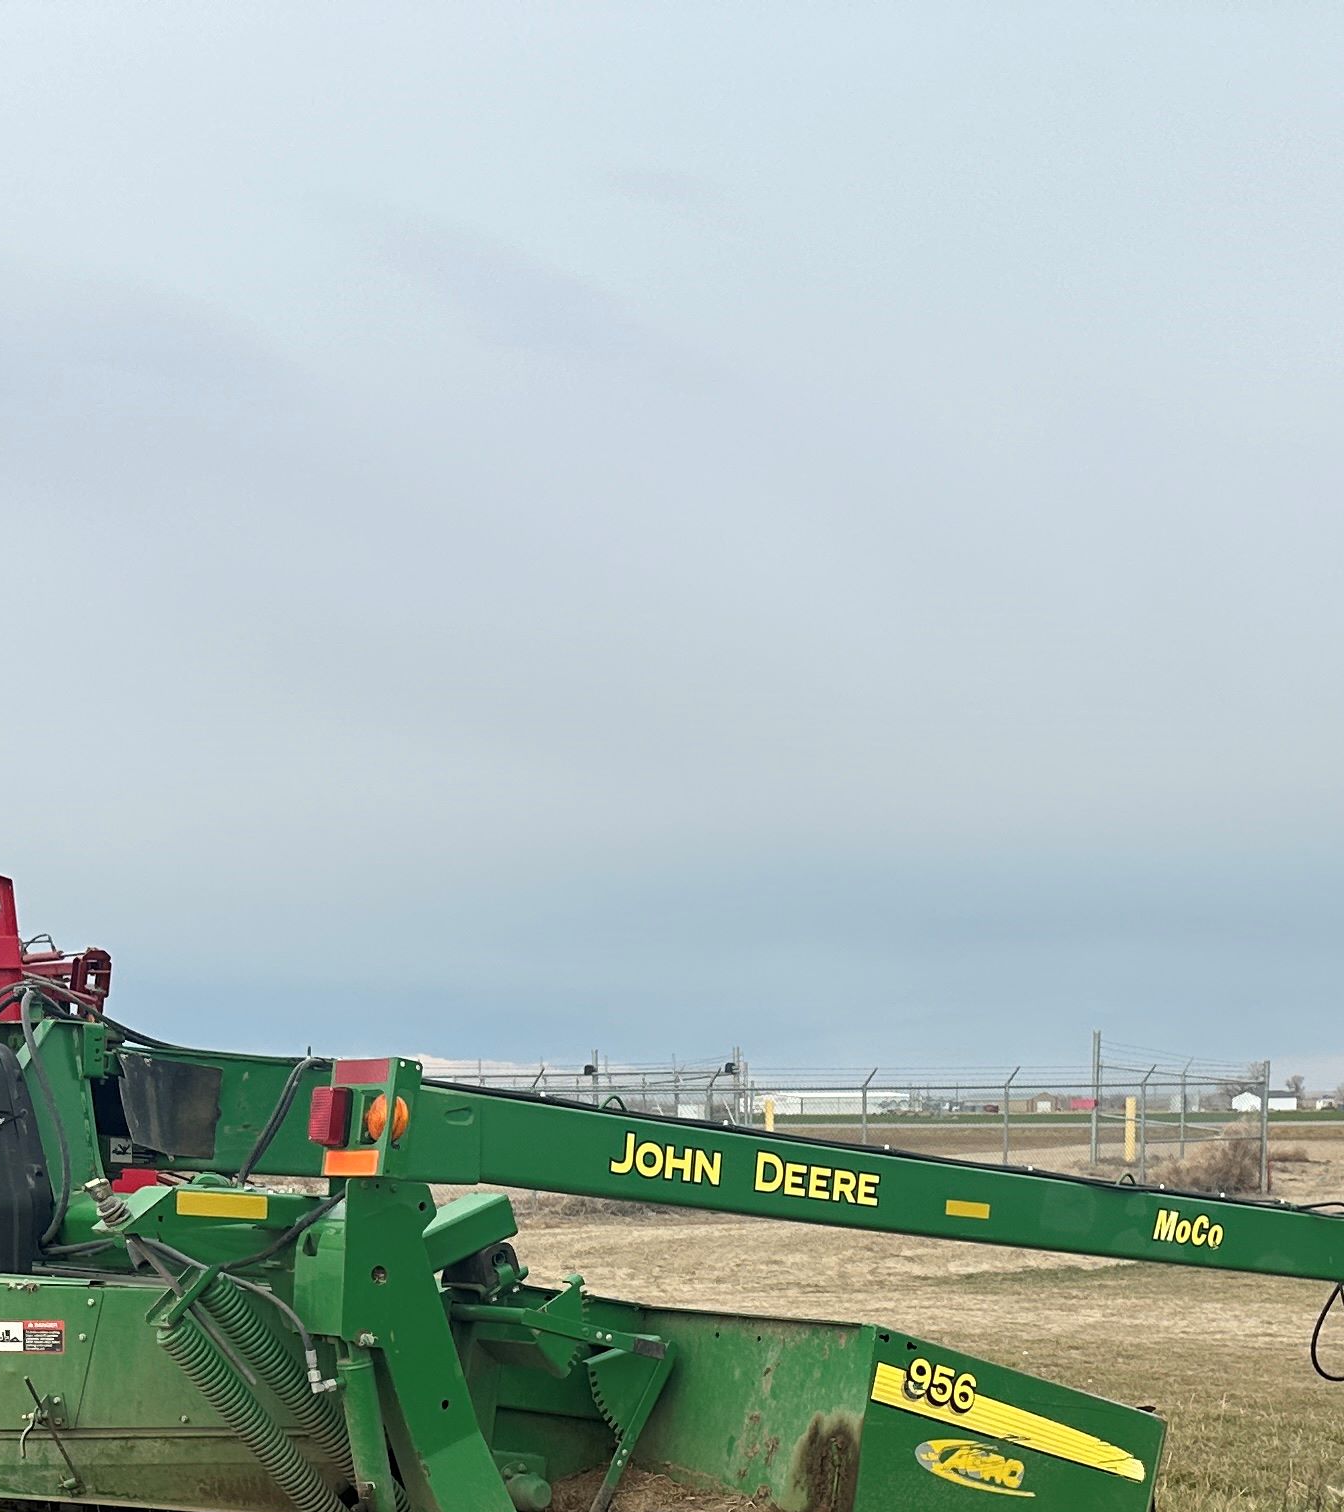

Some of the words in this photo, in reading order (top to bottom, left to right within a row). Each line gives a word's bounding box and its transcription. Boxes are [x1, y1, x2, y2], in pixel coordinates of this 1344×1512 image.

[610, 1132, 722, 1187] JOHN
[754, 1150, 881, 1207] DEERE
[1152, 1209, 1224, 1249] MoCo
[906, 1357, 977, 1413] 956
